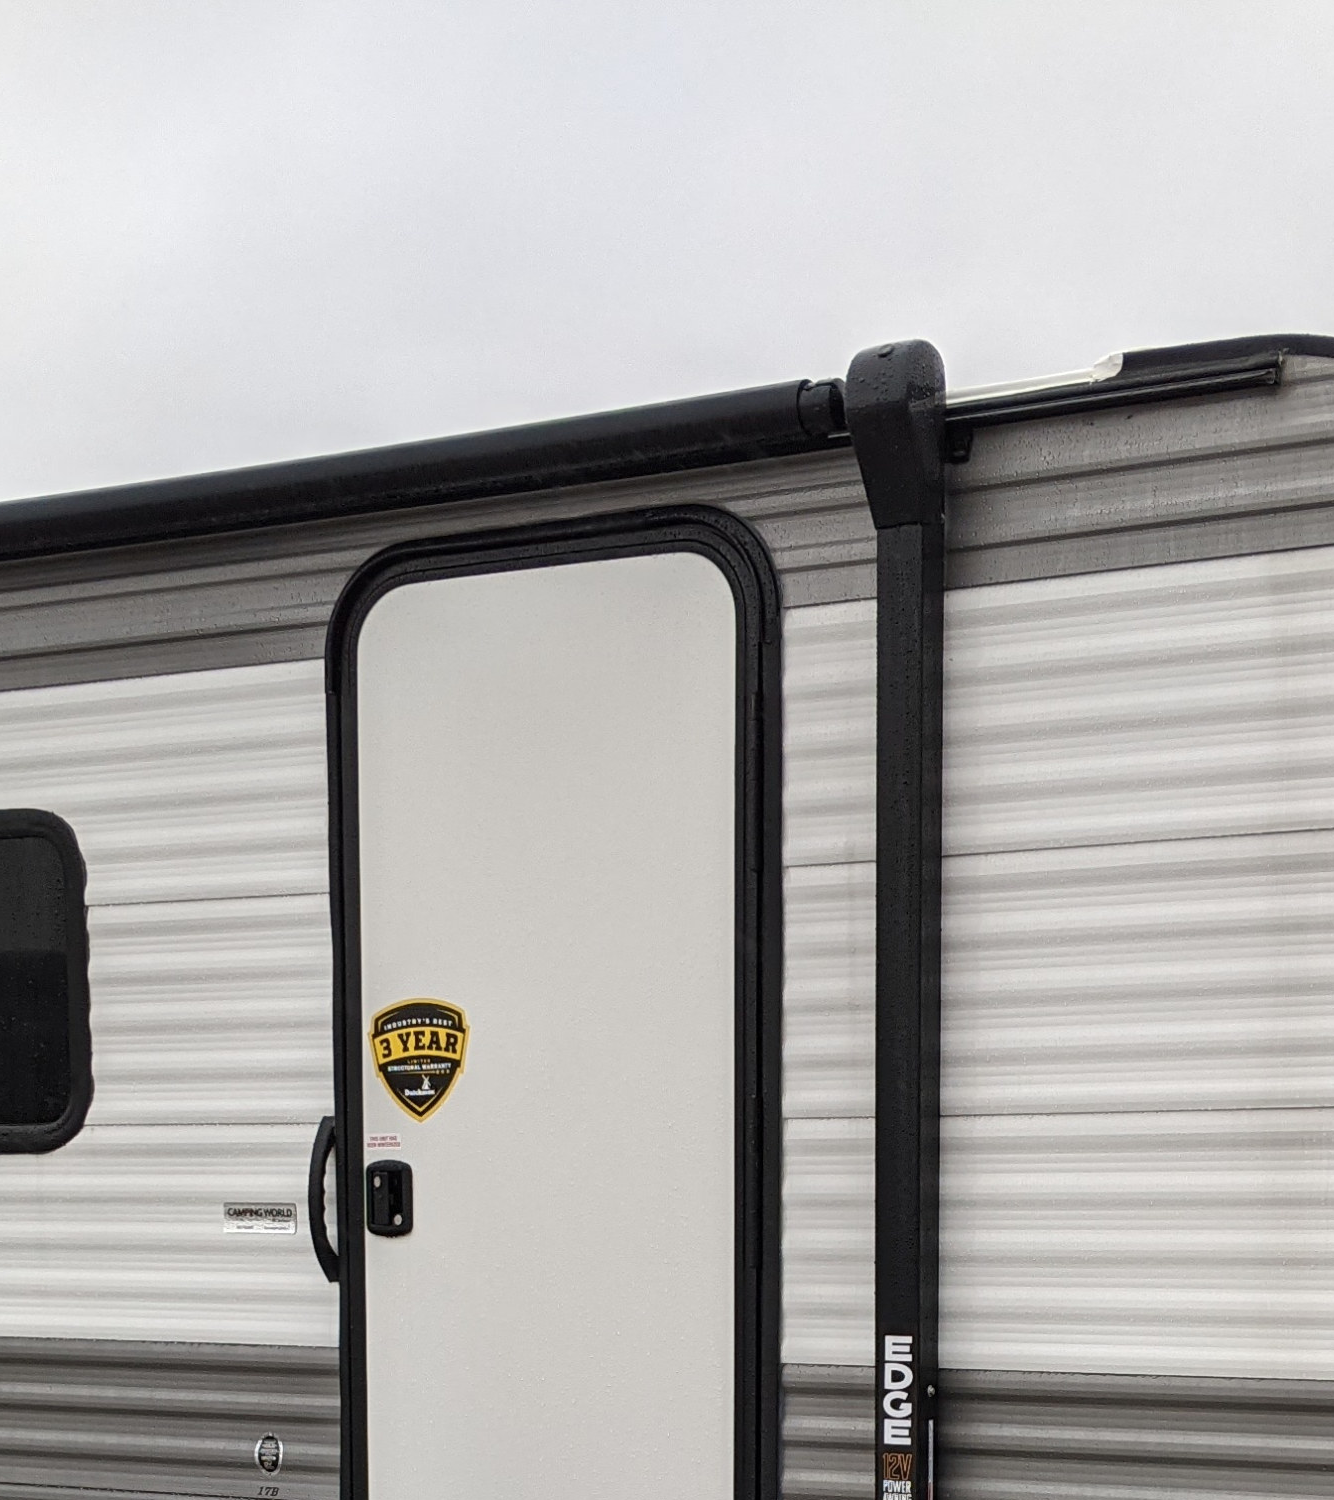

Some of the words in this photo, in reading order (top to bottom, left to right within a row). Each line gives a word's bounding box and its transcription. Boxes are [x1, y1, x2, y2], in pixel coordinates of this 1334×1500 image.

[383, 1018, 430, 1031] INDUSTRY'S
[432, 1018, 454, 1027] BEST
[379, 1037, 393, 1059] 3
[397, 1030, 459, 1055] YEAR
[227, 1207, 263, 1218] CAMPING
[263, 1207, 293, 1218] WORLD
[882, 1335, 914, 1446] EDGE
[882, 1453, 913, 1480] 12V
[257, 1486, 279, 1497] 17B
[882, 1480, 912, 1494] POWER
